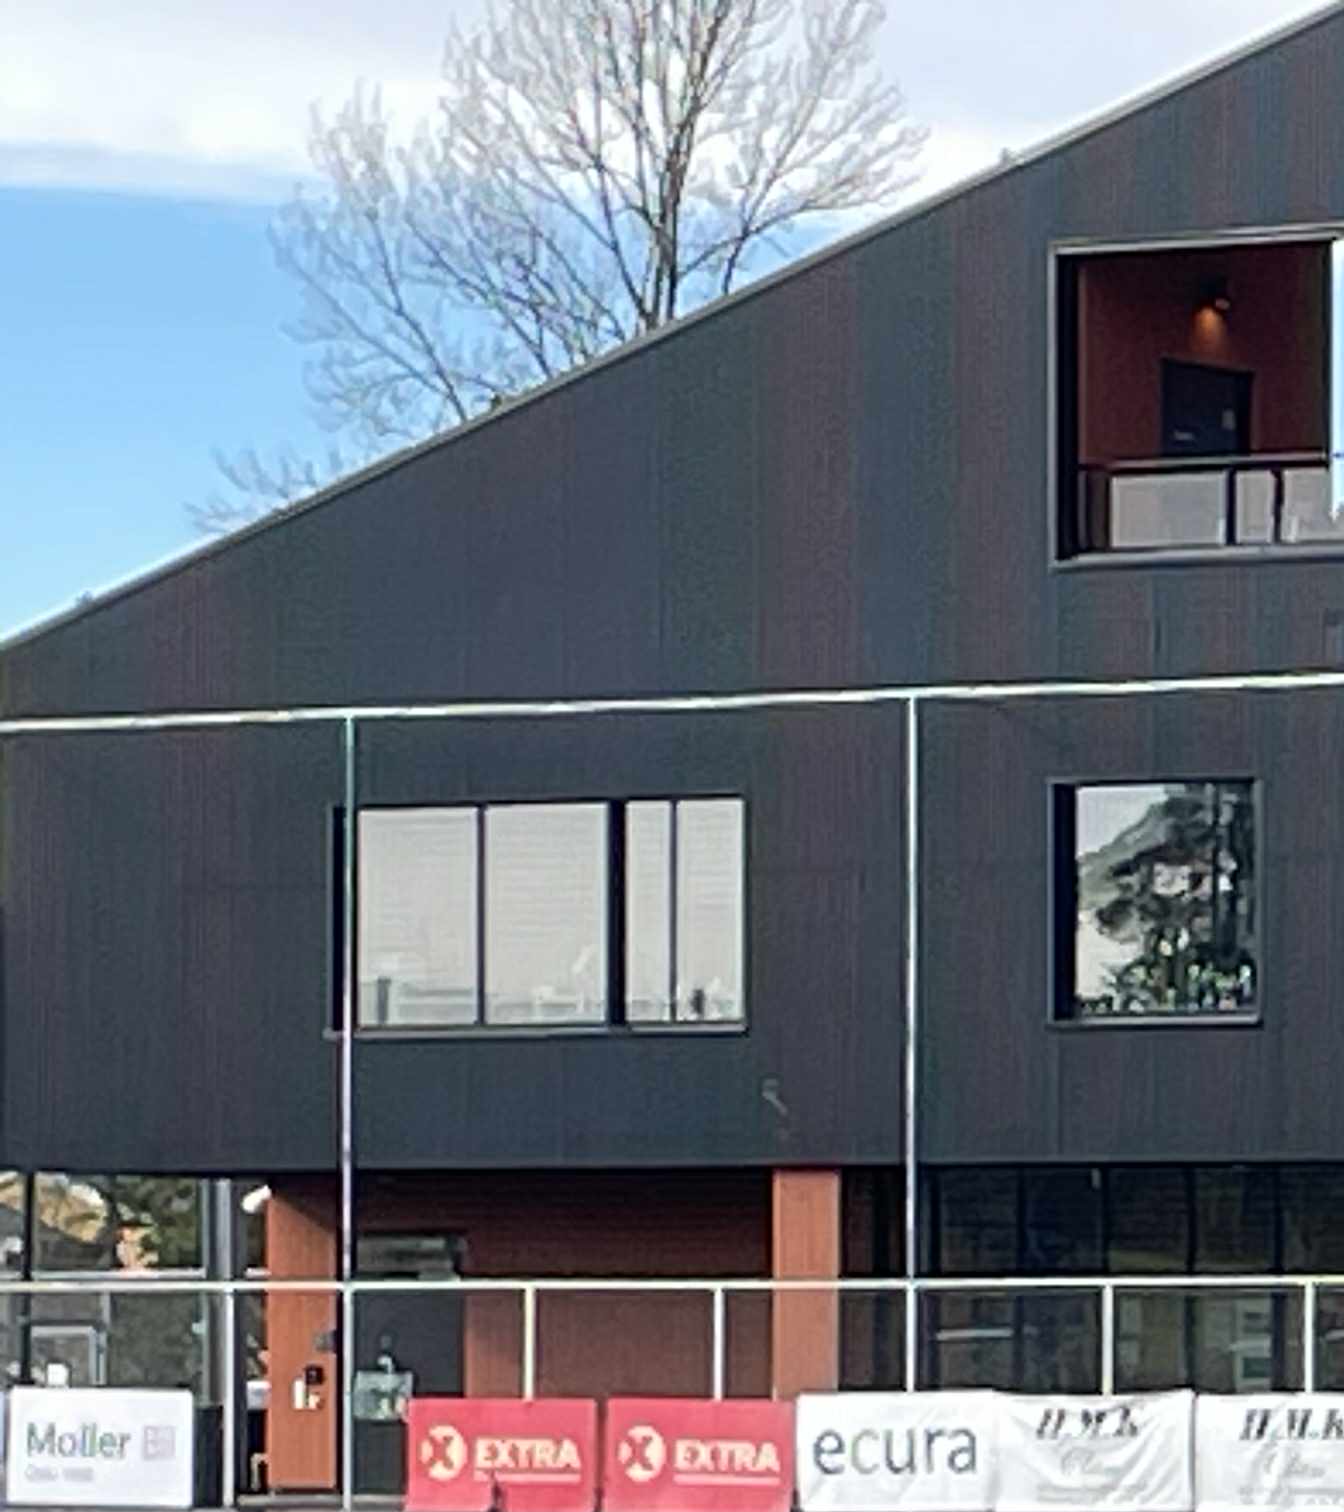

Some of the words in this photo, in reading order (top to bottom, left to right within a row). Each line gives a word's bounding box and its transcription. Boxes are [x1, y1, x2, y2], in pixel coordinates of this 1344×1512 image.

[474, 1437, 582, 1470] EXTRA
[672, 1438, 781, 1473] EXTRA
[813, 1429, 977, 1474] ecura
